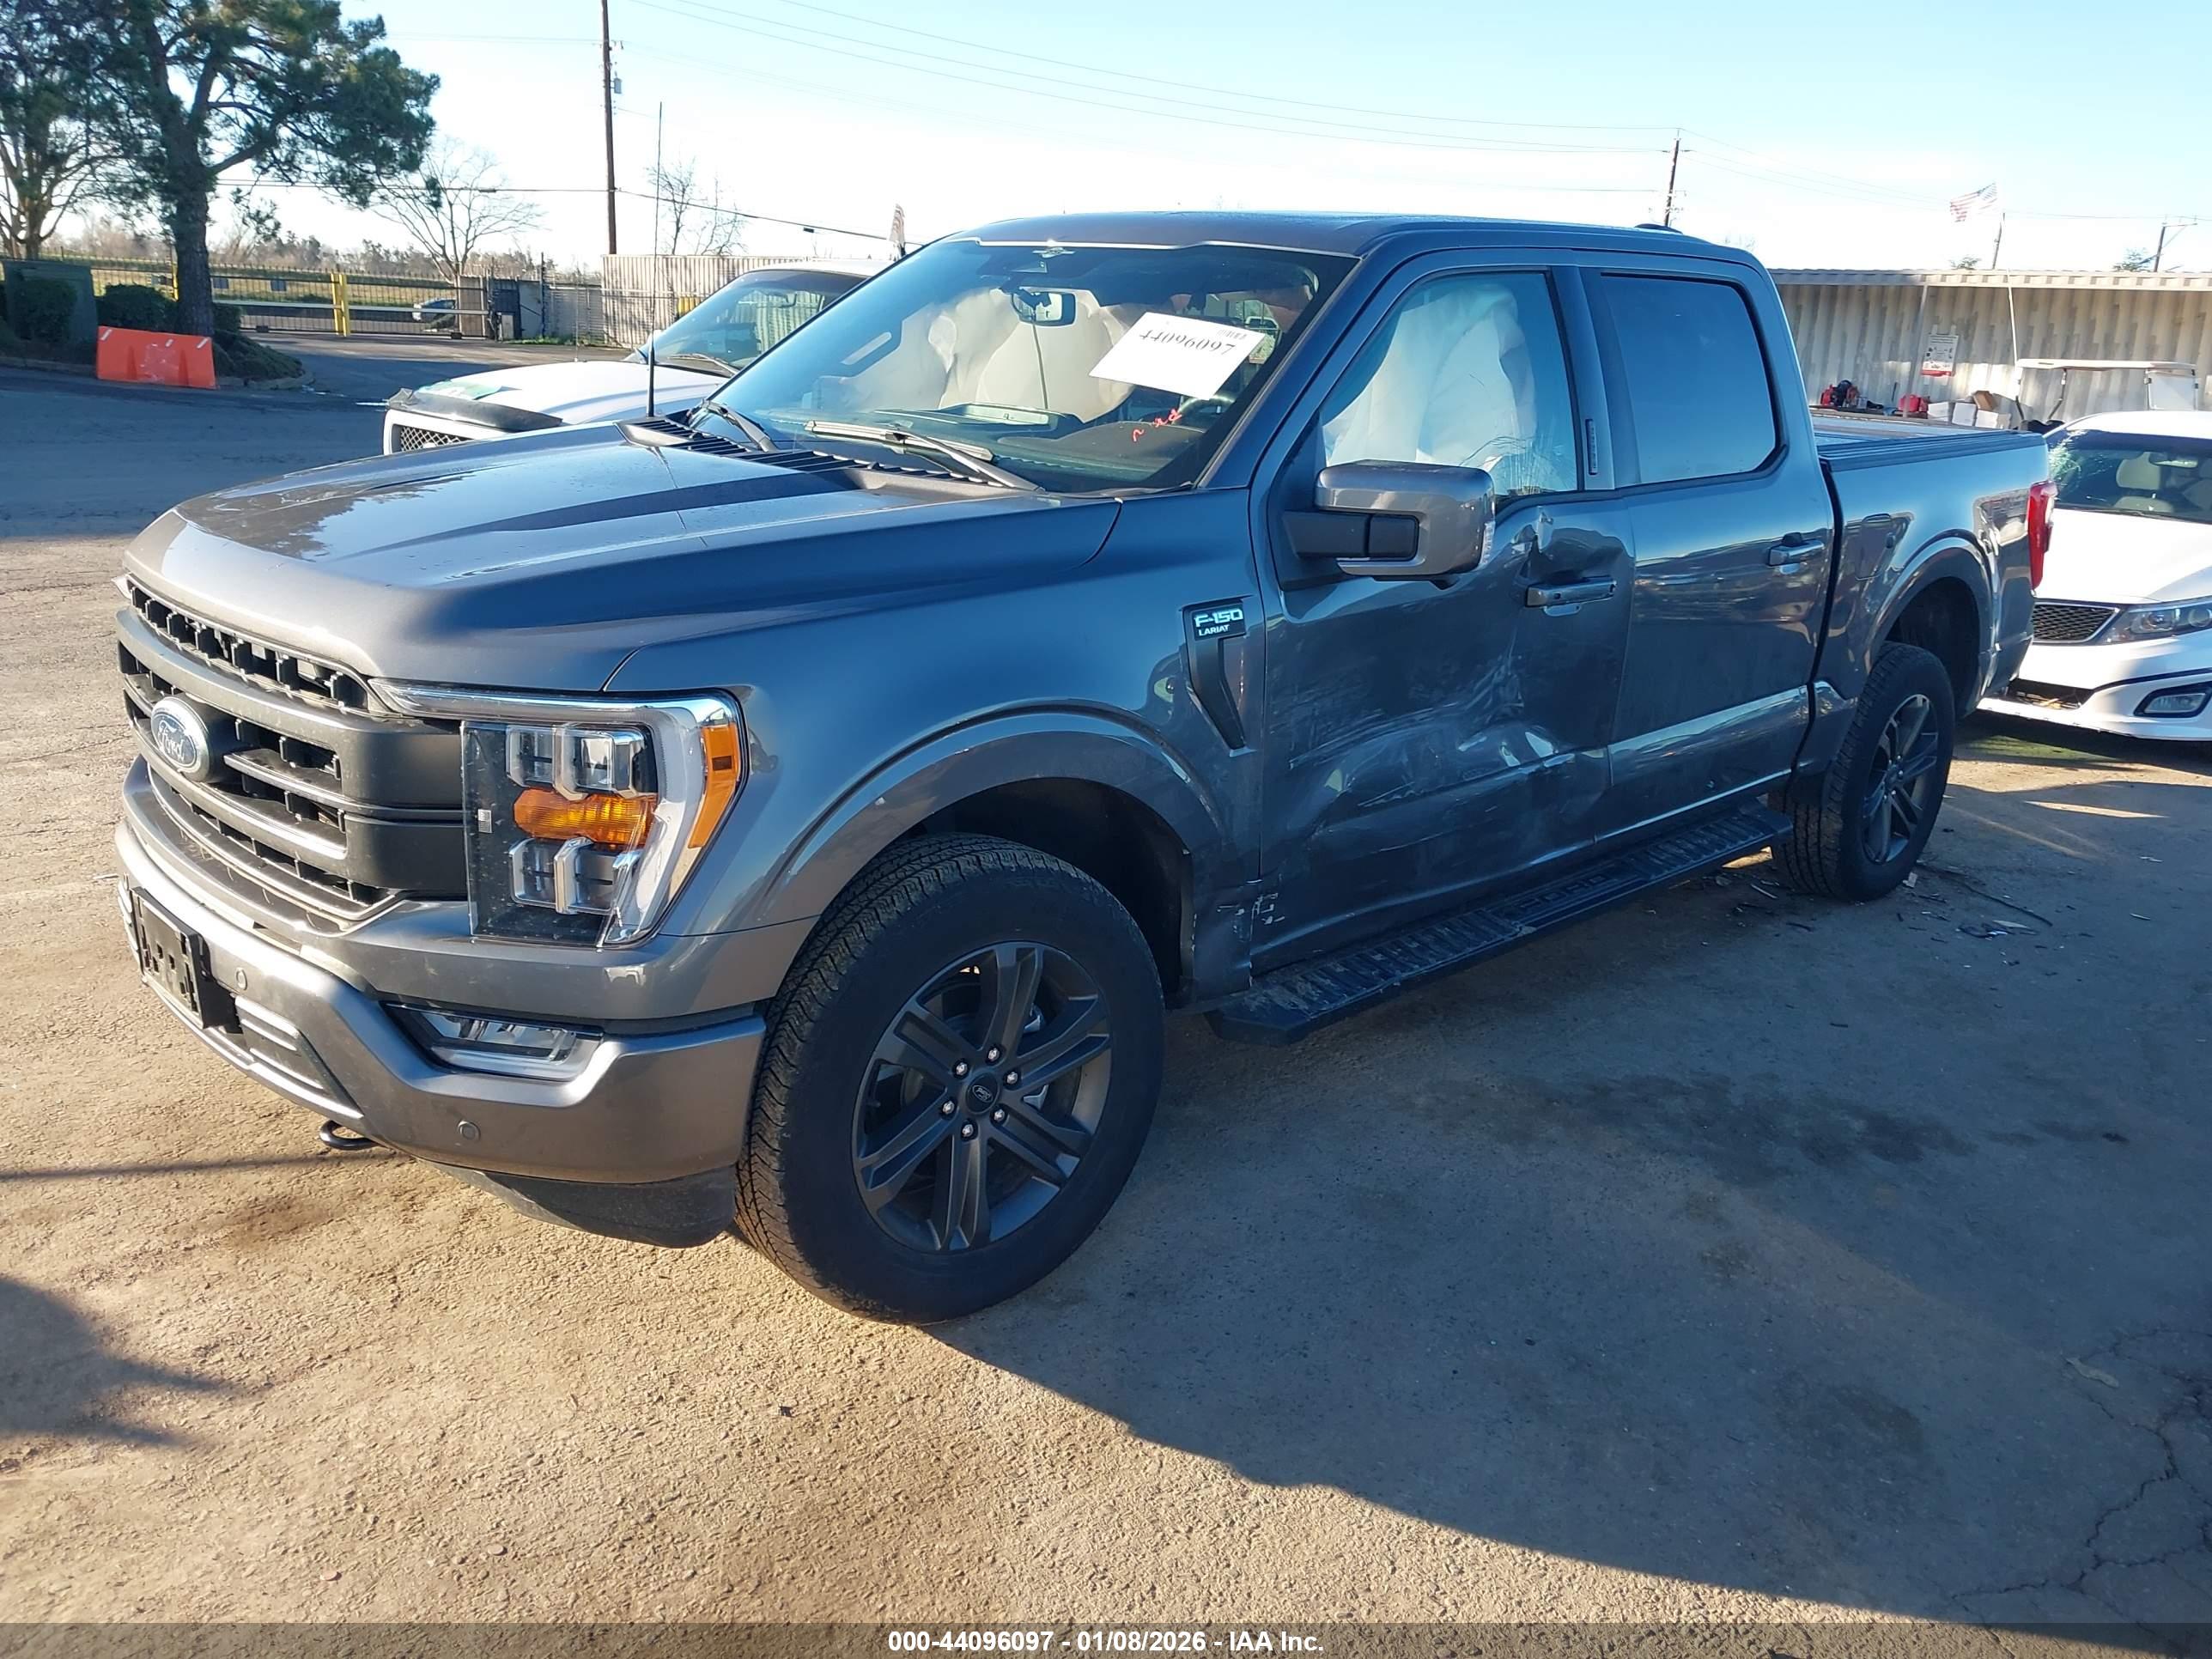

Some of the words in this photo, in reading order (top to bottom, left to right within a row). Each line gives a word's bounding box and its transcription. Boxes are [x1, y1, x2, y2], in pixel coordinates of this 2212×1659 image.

[1139, 329, 1236, 356] 44096097
[1194, 608, 1244, 628] F-150
[1198, 624, 1231, 636] LARIAT
[158, 720, 185, 762] Ford
